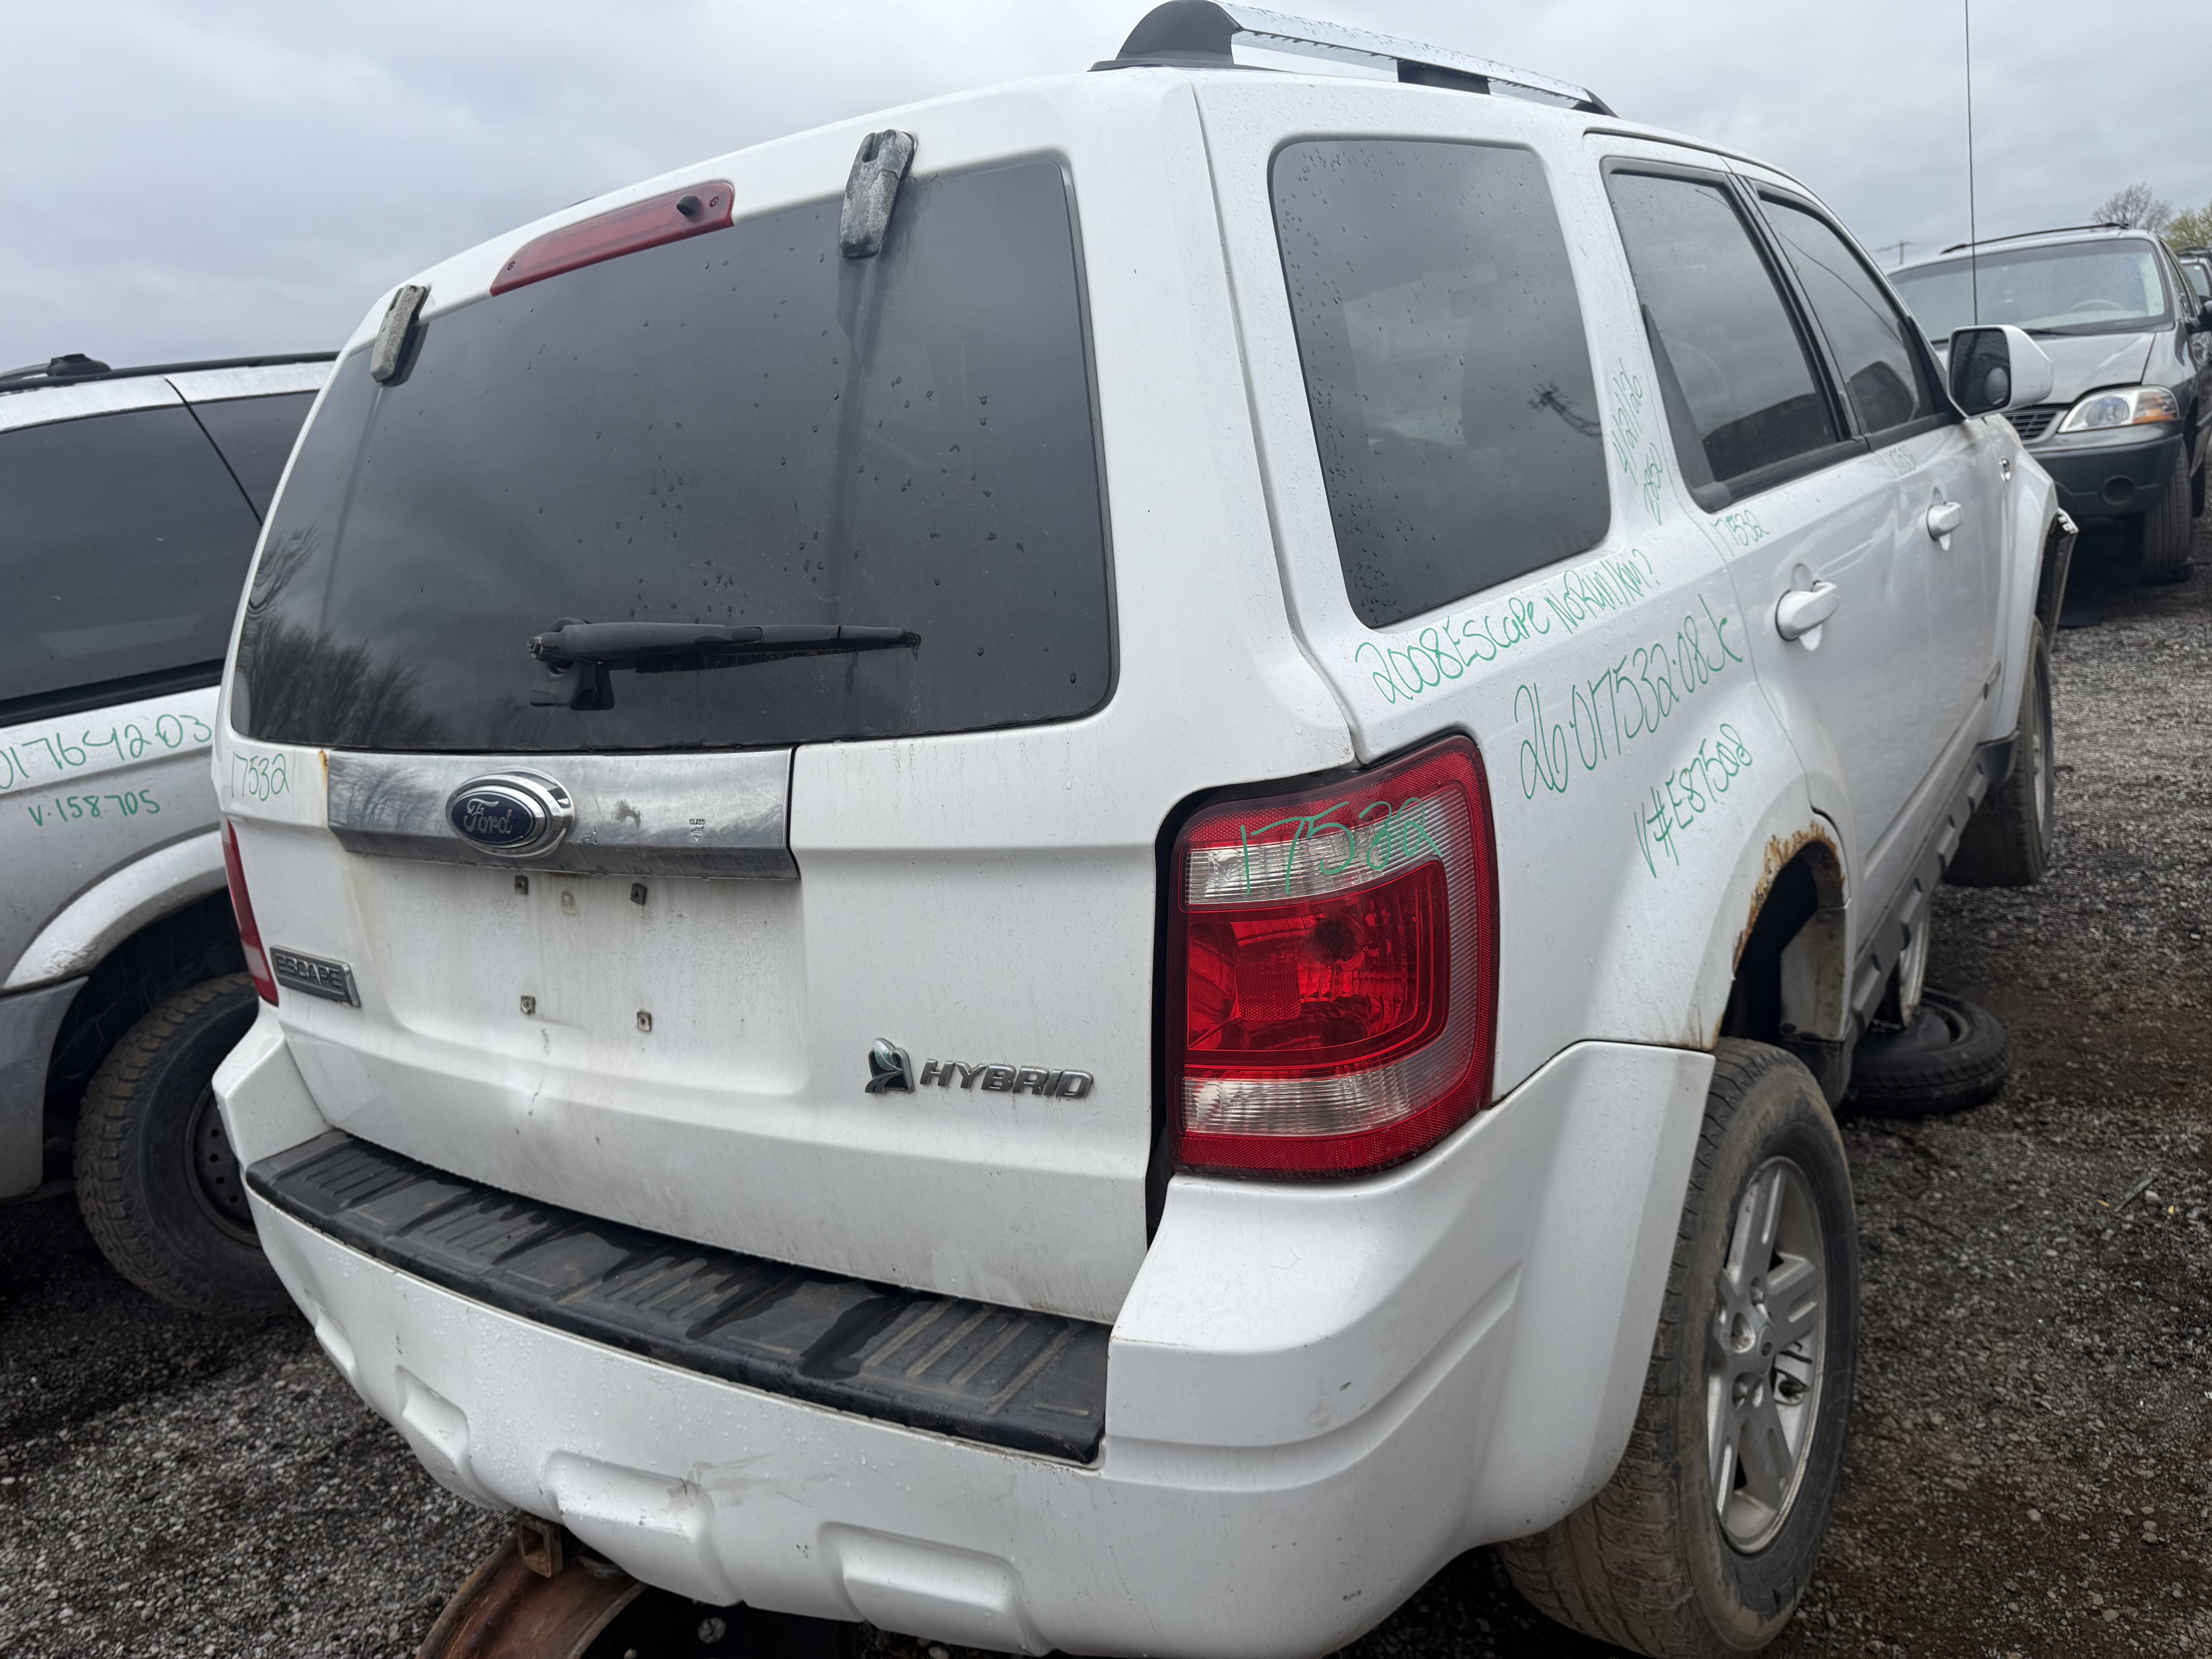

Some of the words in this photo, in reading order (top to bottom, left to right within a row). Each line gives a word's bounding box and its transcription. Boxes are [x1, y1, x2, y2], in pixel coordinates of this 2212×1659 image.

[231, 750, 290, 802] 17532
[464, 798, 513, 834] Ford
[1240, 797, 1442, 896] 17532
[275, 952, 343, 987] ESCAPE
[919, 1058, 1094, 1099] HYBRID
